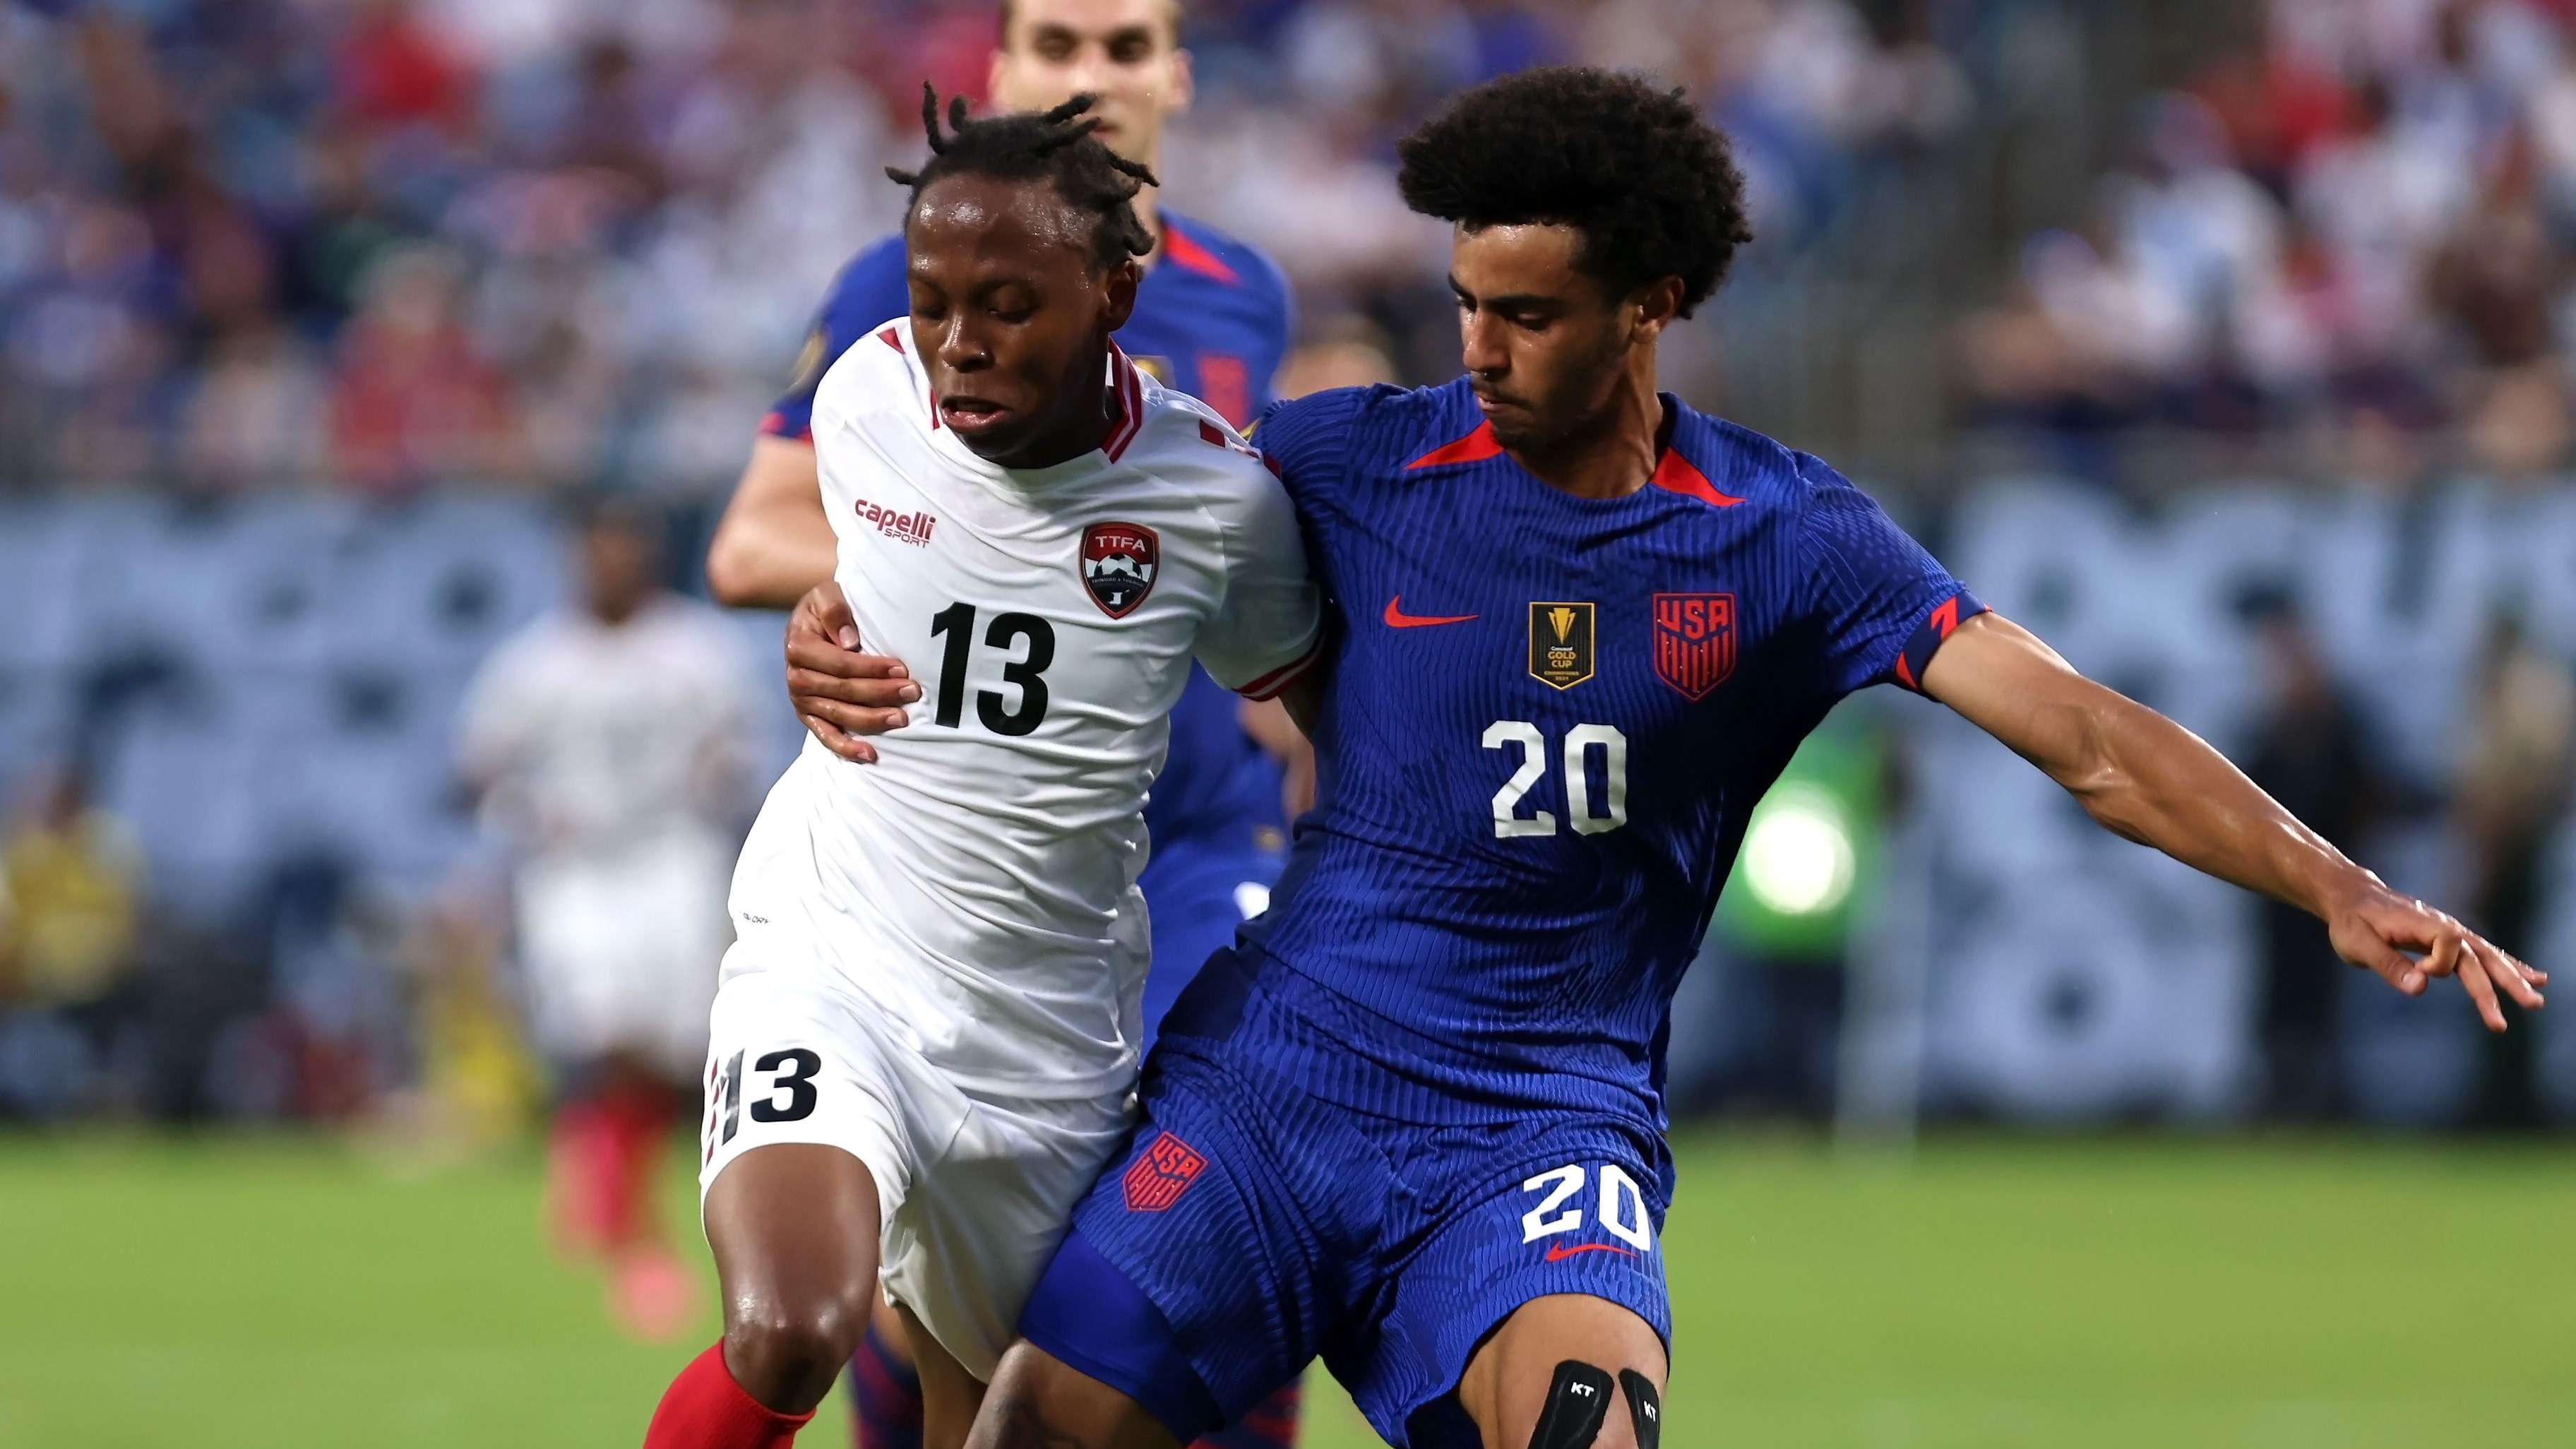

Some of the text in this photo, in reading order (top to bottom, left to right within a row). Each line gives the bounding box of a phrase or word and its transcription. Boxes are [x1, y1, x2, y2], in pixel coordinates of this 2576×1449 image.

[854, 499, 936, 540] capelli
[883, 527, 930, 549] SPORT
[1095, 535, 1145, 552] TTFA
[1660, 600, 1729, 640] USA
[930, 601, 1056, 737] 13
[1547, 651, 1577, 660] GOLD
[1551, 660, 1573, 668] CUP
[1481, 720, 1628, 838] 20
[719, 1047, 822, 1147] 13
[1152, 1138, 1200, 1178] USA
[1522, 1164, 1651, 1252] 20
[1570, 1381, 1595, 1398] KT
[1642, 1400, 1657, 1423] KT
